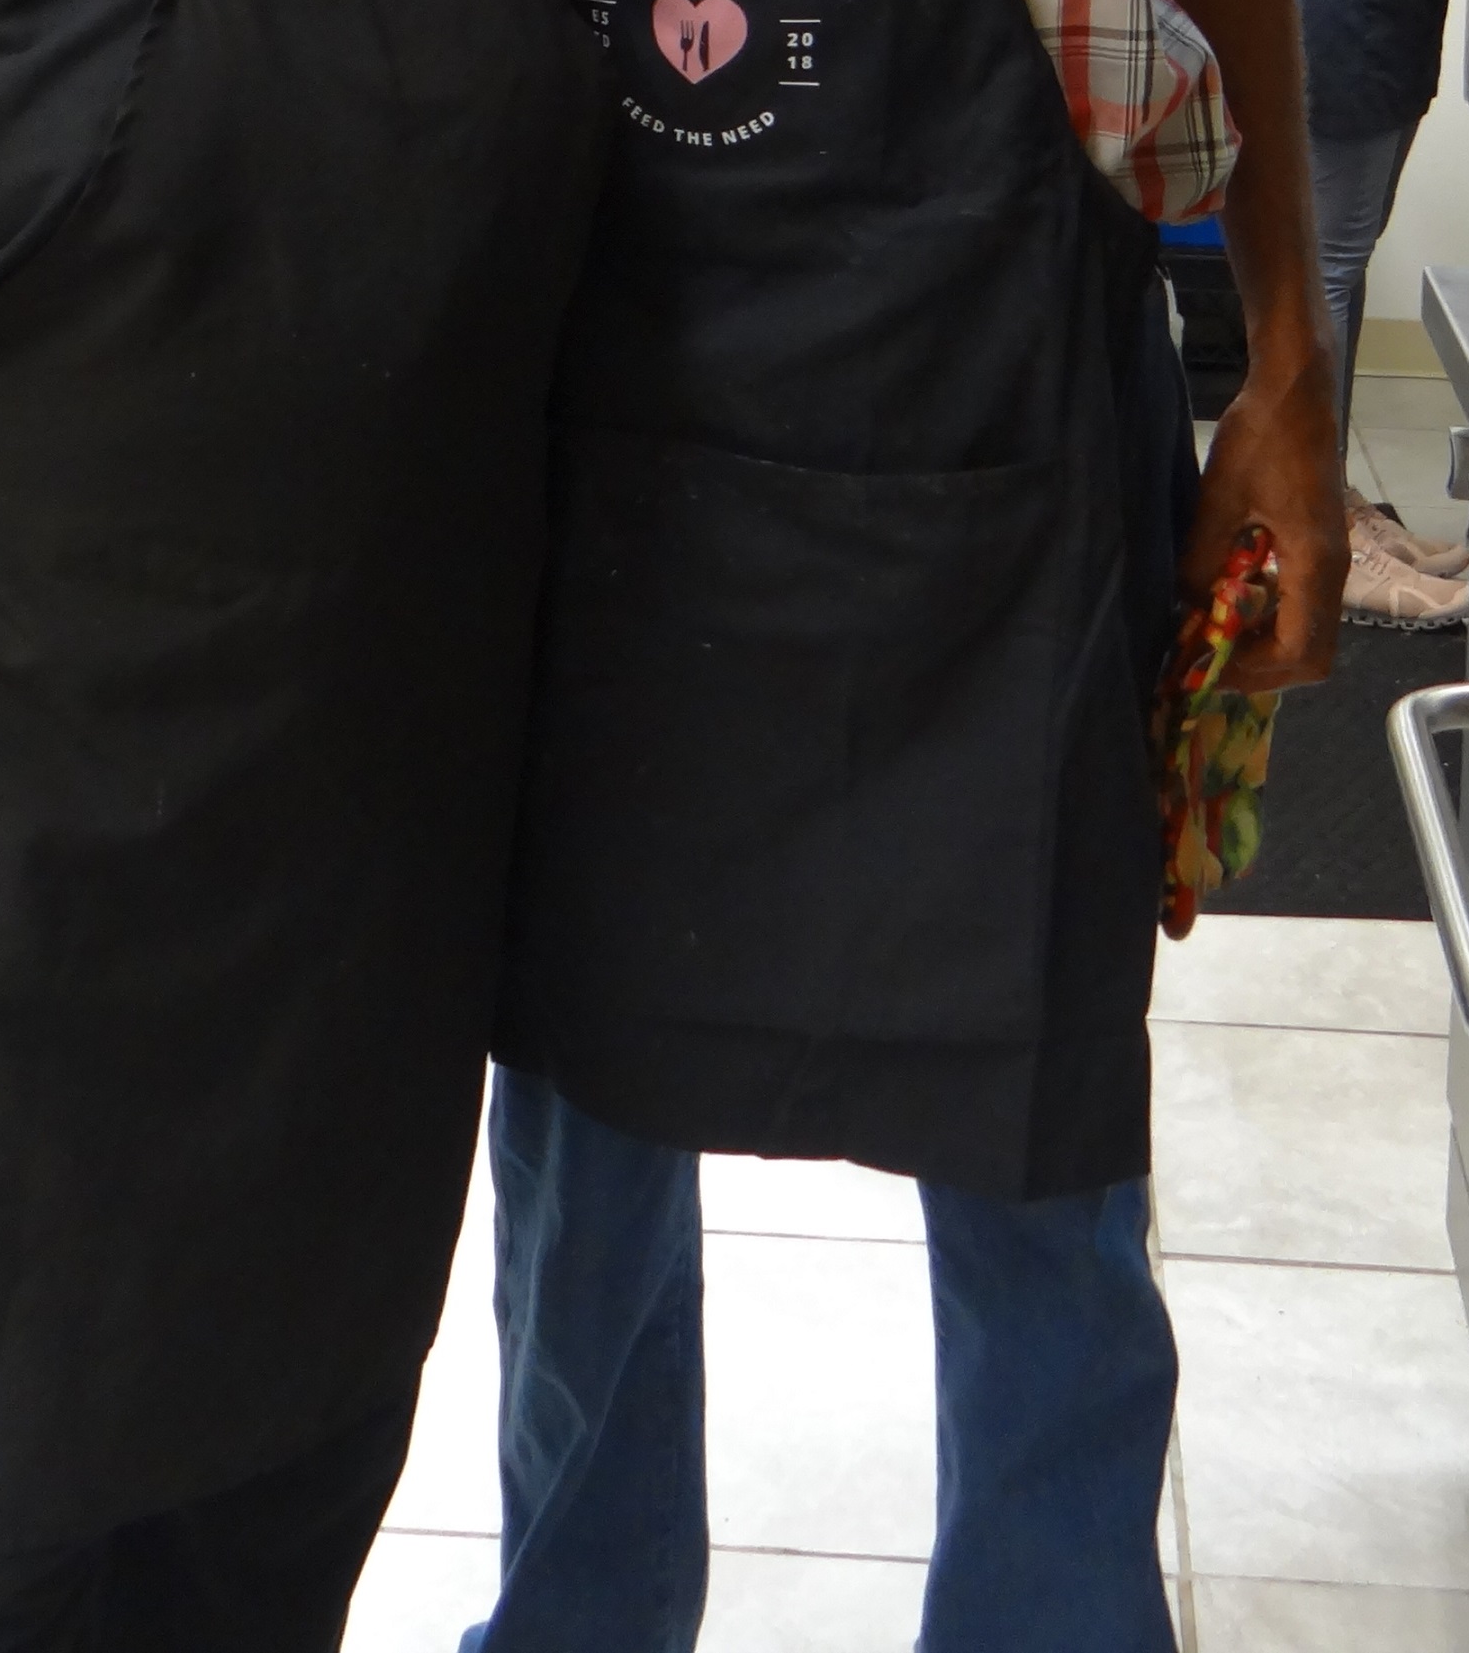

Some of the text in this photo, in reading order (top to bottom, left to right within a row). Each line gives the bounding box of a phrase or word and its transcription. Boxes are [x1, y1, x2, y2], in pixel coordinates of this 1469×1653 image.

[787, 32, 814, 47] 20
[787, 55, 814, 70] 18
[622, 97, 776, 146] FEED THE NEED
